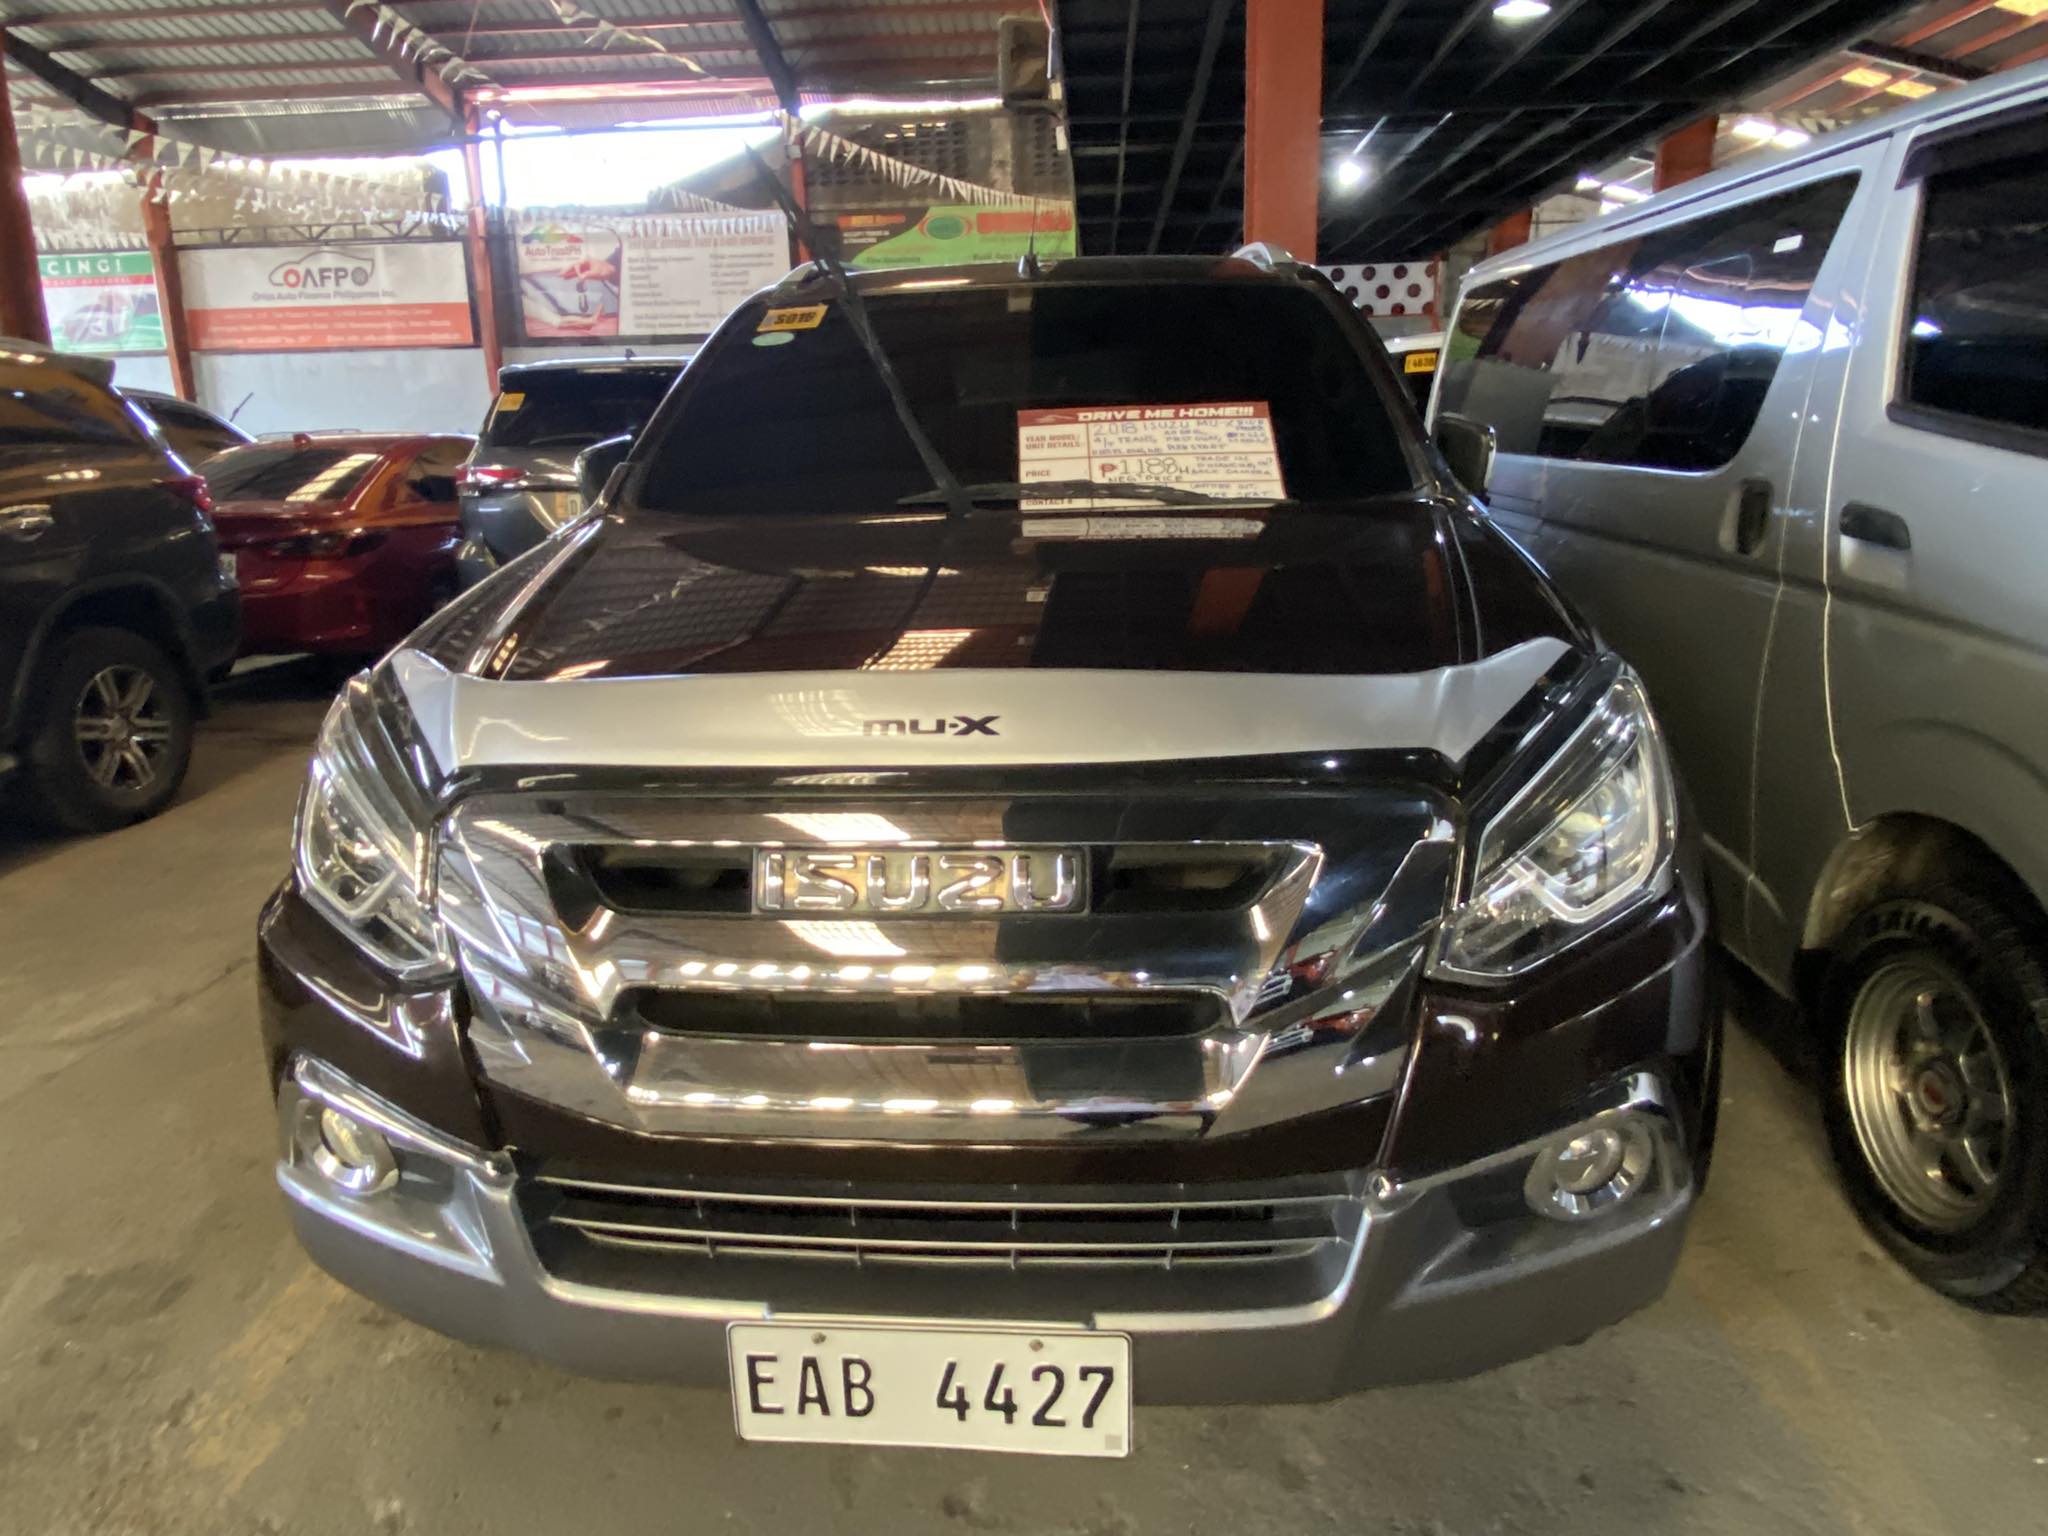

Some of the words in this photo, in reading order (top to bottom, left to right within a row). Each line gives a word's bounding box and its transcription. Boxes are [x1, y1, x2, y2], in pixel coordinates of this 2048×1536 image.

[1077, 410, 1142, 422] DRIVE
[1144, 409, 1175, 419] ME
[1179, 406, 1254, 418] HOME!!!
[1094, 423, 1138, 437] 2018
[1143, 420, 1189, 431] ISUZU
[1025, 470, 1050, 478] PRICE
[765, 853, 1078, 912] ISUZU
[746, 1353, 876, 1418] EAB
[936, 1361, 1115, 1429] 4427
